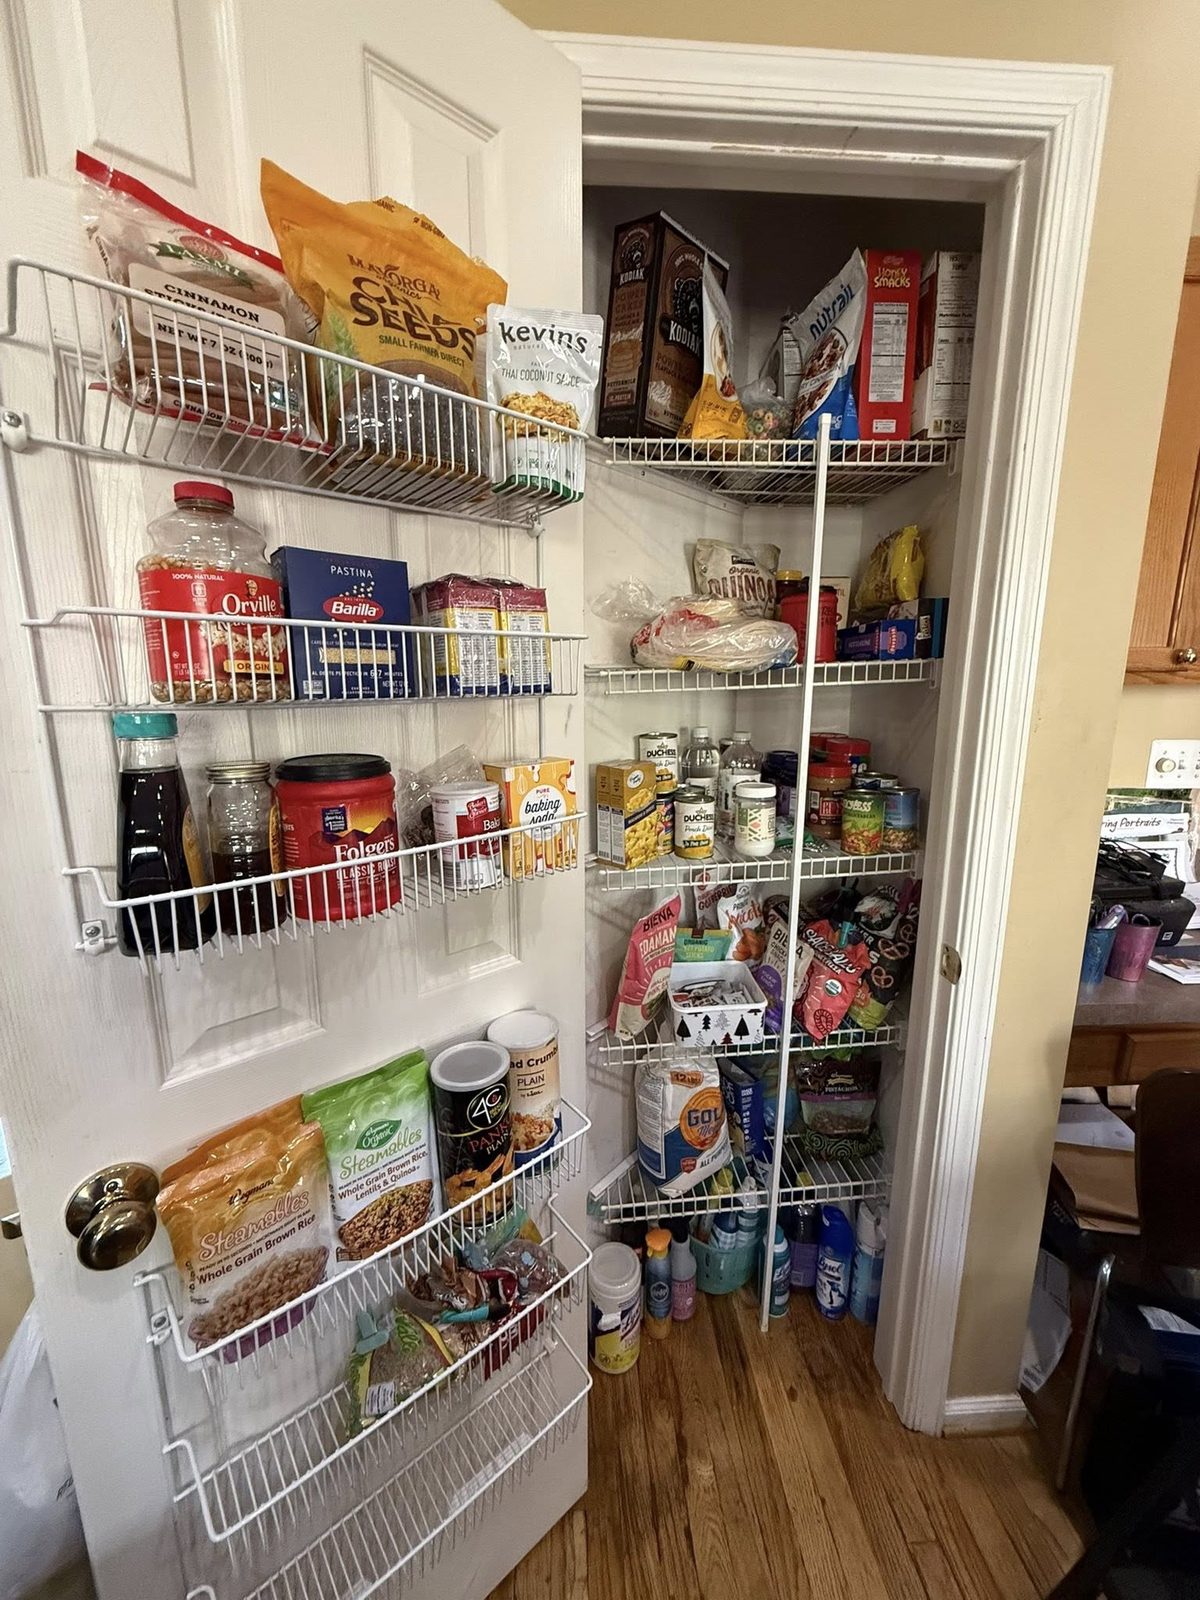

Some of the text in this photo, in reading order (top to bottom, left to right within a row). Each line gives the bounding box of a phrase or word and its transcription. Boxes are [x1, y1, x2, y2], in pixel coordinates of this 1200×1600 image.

[165, 243, 240, 277] LAXMI
[347, 253, 441, 300] MAYORGA
[619, 268, 645, 285] KODIAK
[874, 277, 911, 288] SMACKS
[164, 284, 260, 323] CINNAMON
[352, 276, 462, 326] CHIA
[157, 322, 184, 338] NET
[187, 331, 207, 346] WT
[210, 339, 217, 349] 7
[350, 291, 477, 362] SEEDS
[498, 322, 588, 354] kevin's
[379, 334, 466, 368] SMALL FARMER DIRECT
[502, 368, 518, 380] THAI
[556, 373, 581, 388] SACE
[173, 400, 224, 421] CNNAON
[194, 573, 224, 581] NATURAL
[330, 565, 373, 578] PASTINA
[729, 566, 760, 575] Organic
[222, 593, 277, 615] Orville
[331, 601, 377, 616] Barilla
[237, 662, 279, 671] ORGINL
[370, 669, 382, 678] 67
[647, 749, 676, 758] DUCHESS
[851, 763, 867, 774] if
[525, 798, 561, 814] baking
[483, 817, 500, 831] Baki
[684, 813, 714, 822] DUCHESS
[1120, 817, 1161, 828] Portraits
[334, 836, 395, 864] Folgers
[336, 864, 376, 880] CLASSIC
[642, 906, 675, 933] BIENA
[773, 929, 803, 958] BIEA
[527, 1046, 559, 1068] Crumbs
[517, 1074, 545, 1087] PLAIN
[673, 1072, 686, 1081] 12
[471, 1088, 501, 1124] 4C
[687, 1107, 721, 1128] GOL
[363, 1125, 394, 1148] Organic
[469, 1119, 511, 1153] PANK
[486, 1128, 509, 1155] PLAIN
[340, 1127, 421, 1180] Steamables
[338, 1183, 365, 1200] Whole
[365, 1171, 386, 1187] Grain
[387, 1159, 411, 1175] Brown
[355, 1184, 382, 1201] Lentils
[383, 1179, 389, 1187] &
[390, 1165, 416, 1183] Quinoa
[199, 1190, 310, 1262] Steamables
[196, 1214, 316, 1285] Whole Grain Brown Rice
